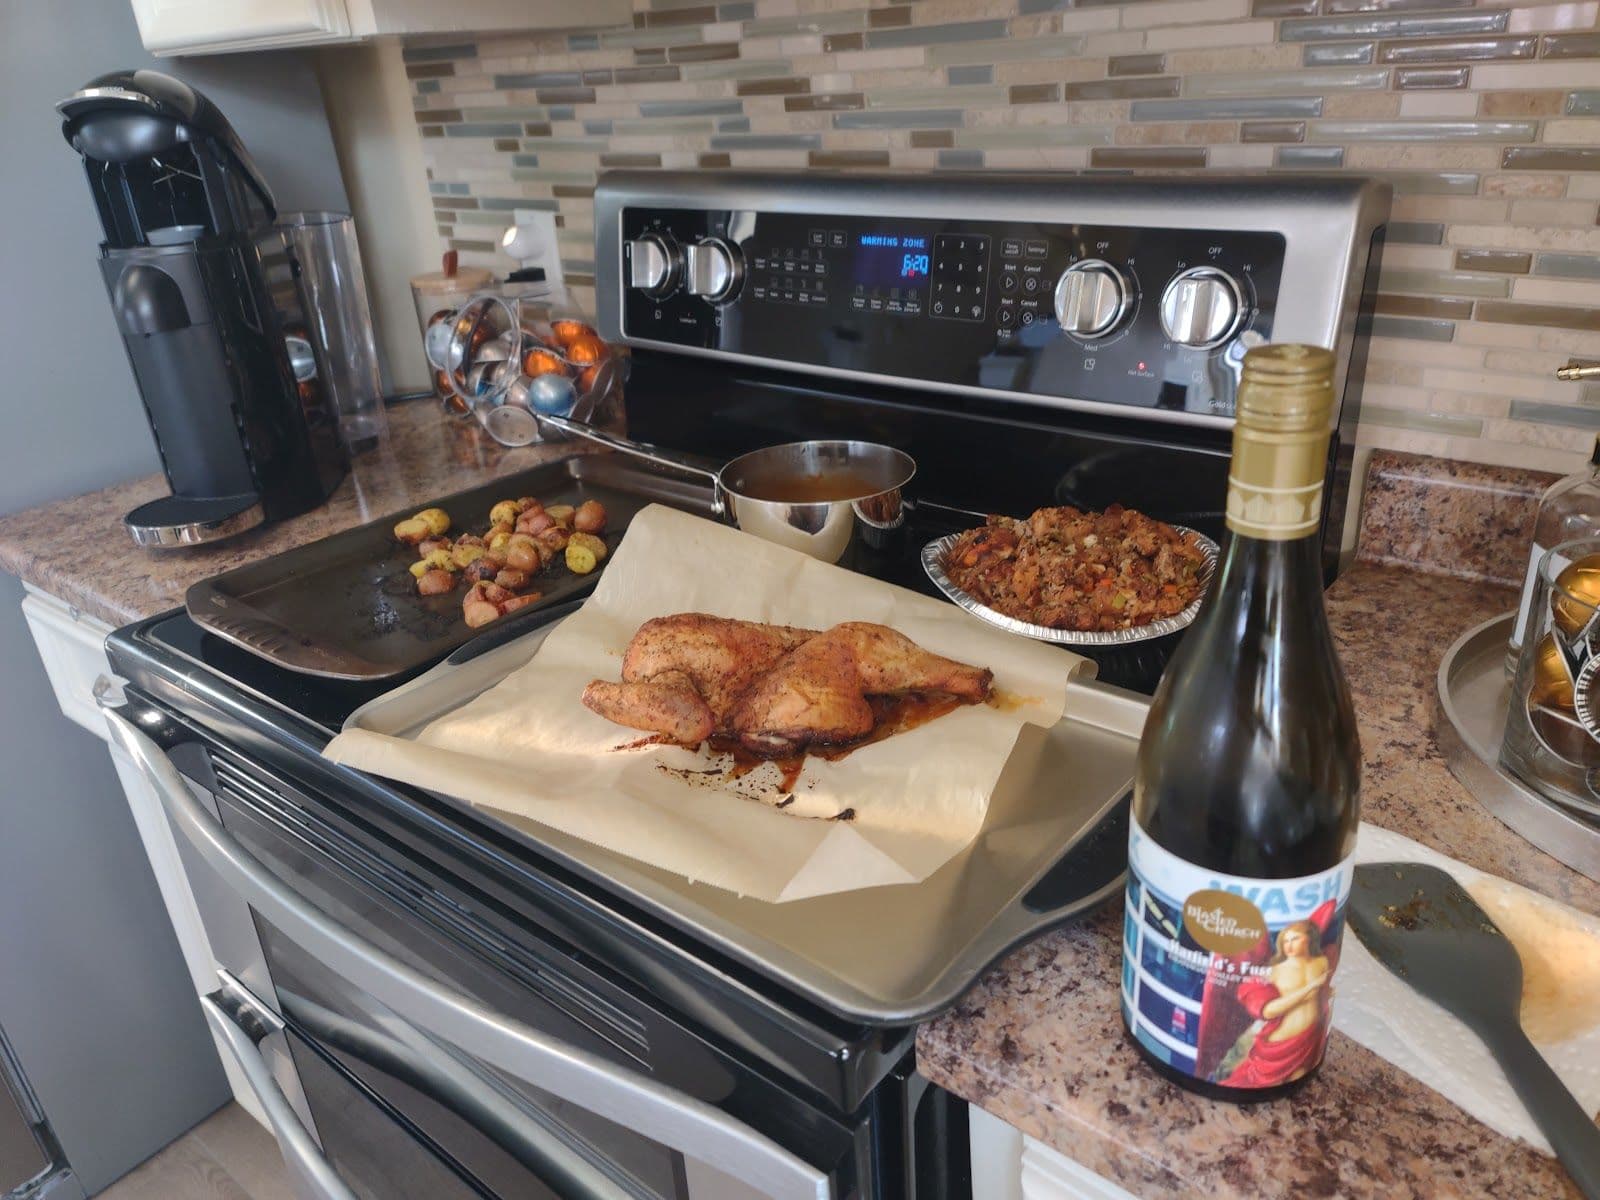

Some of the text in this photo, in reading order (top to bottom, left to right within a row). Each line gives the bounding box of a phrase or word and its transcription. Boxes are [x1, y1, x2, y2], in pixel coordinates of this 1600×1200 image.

[861, 235, 925, 248] WARMING ZONE
[1208, 247, 1222, 255] OFF
[903, 253, 929, 274] 6:20
[1177, 261, 1186, 269] Lo
[1023, 264, 1042, 272] Cancel
